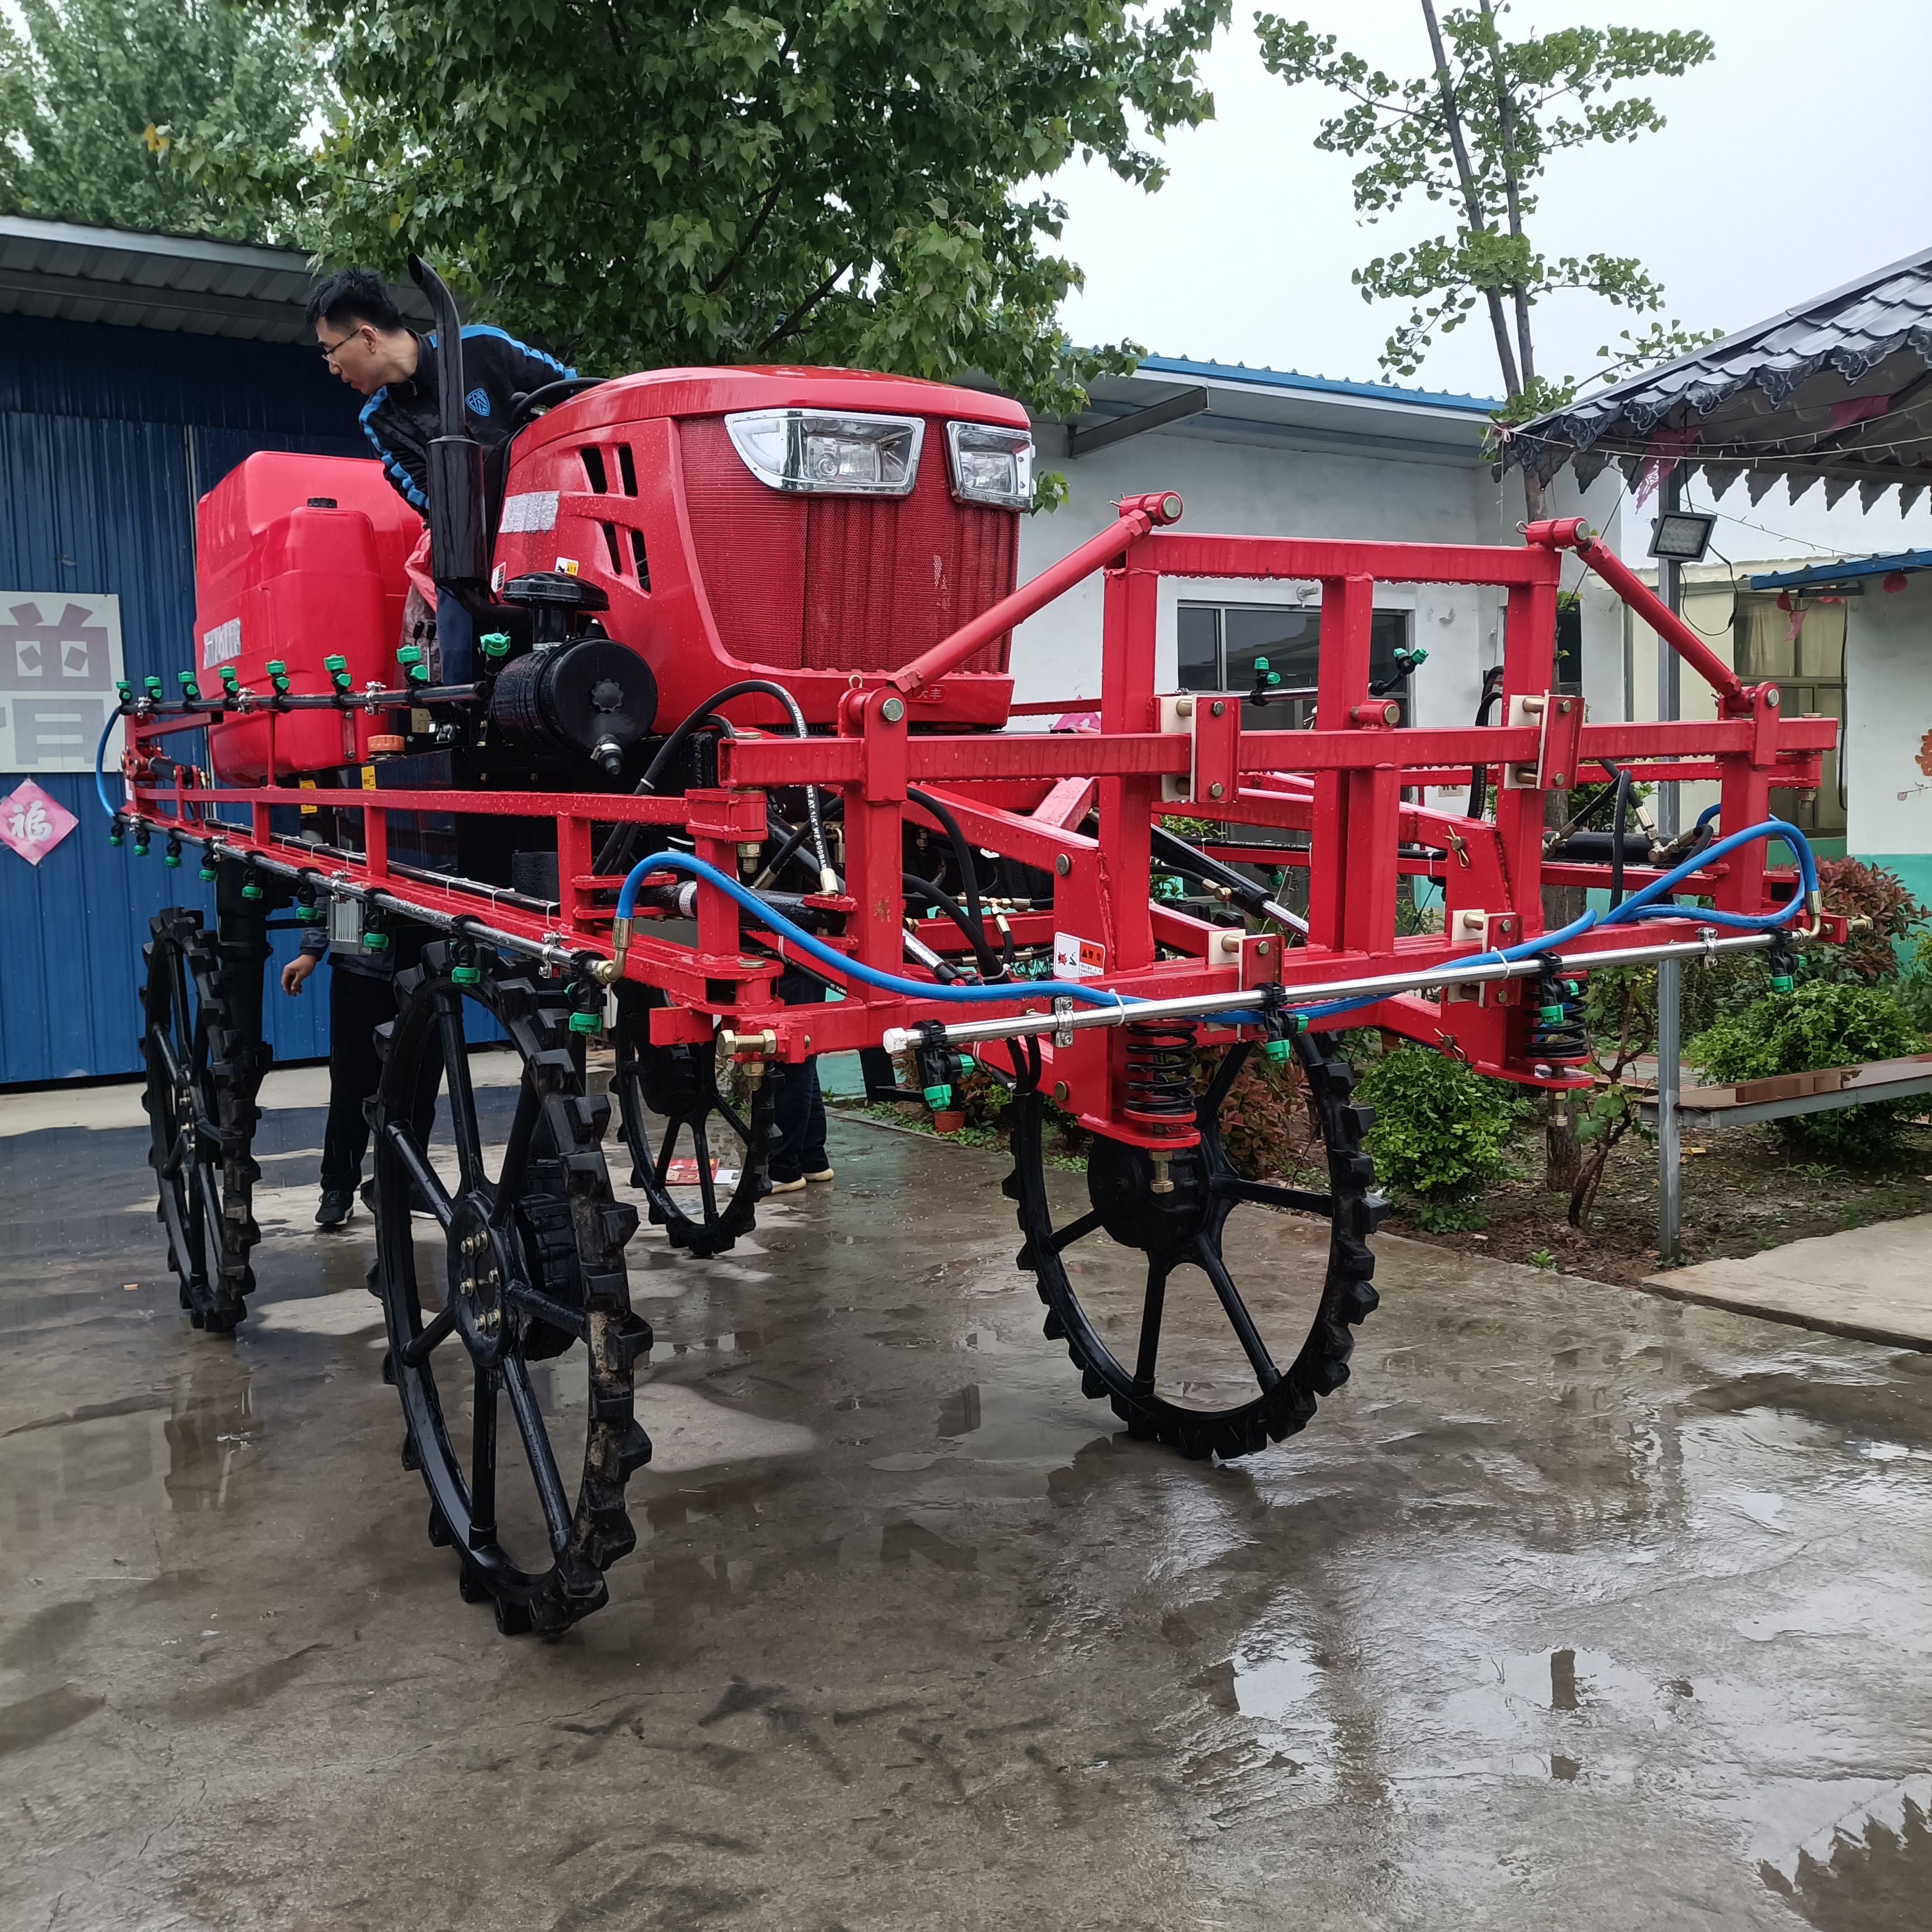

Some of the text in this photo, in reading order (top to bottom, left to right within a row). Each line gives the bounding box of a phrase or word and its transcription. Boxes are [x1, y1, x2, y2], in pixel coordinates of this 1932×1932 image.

[792, 706, 807, 738] HYDRAULIC
[8, 799, 53, 844] 福
[808, 799, 815, 810] AT
[813, 827, 821, 840] WP
